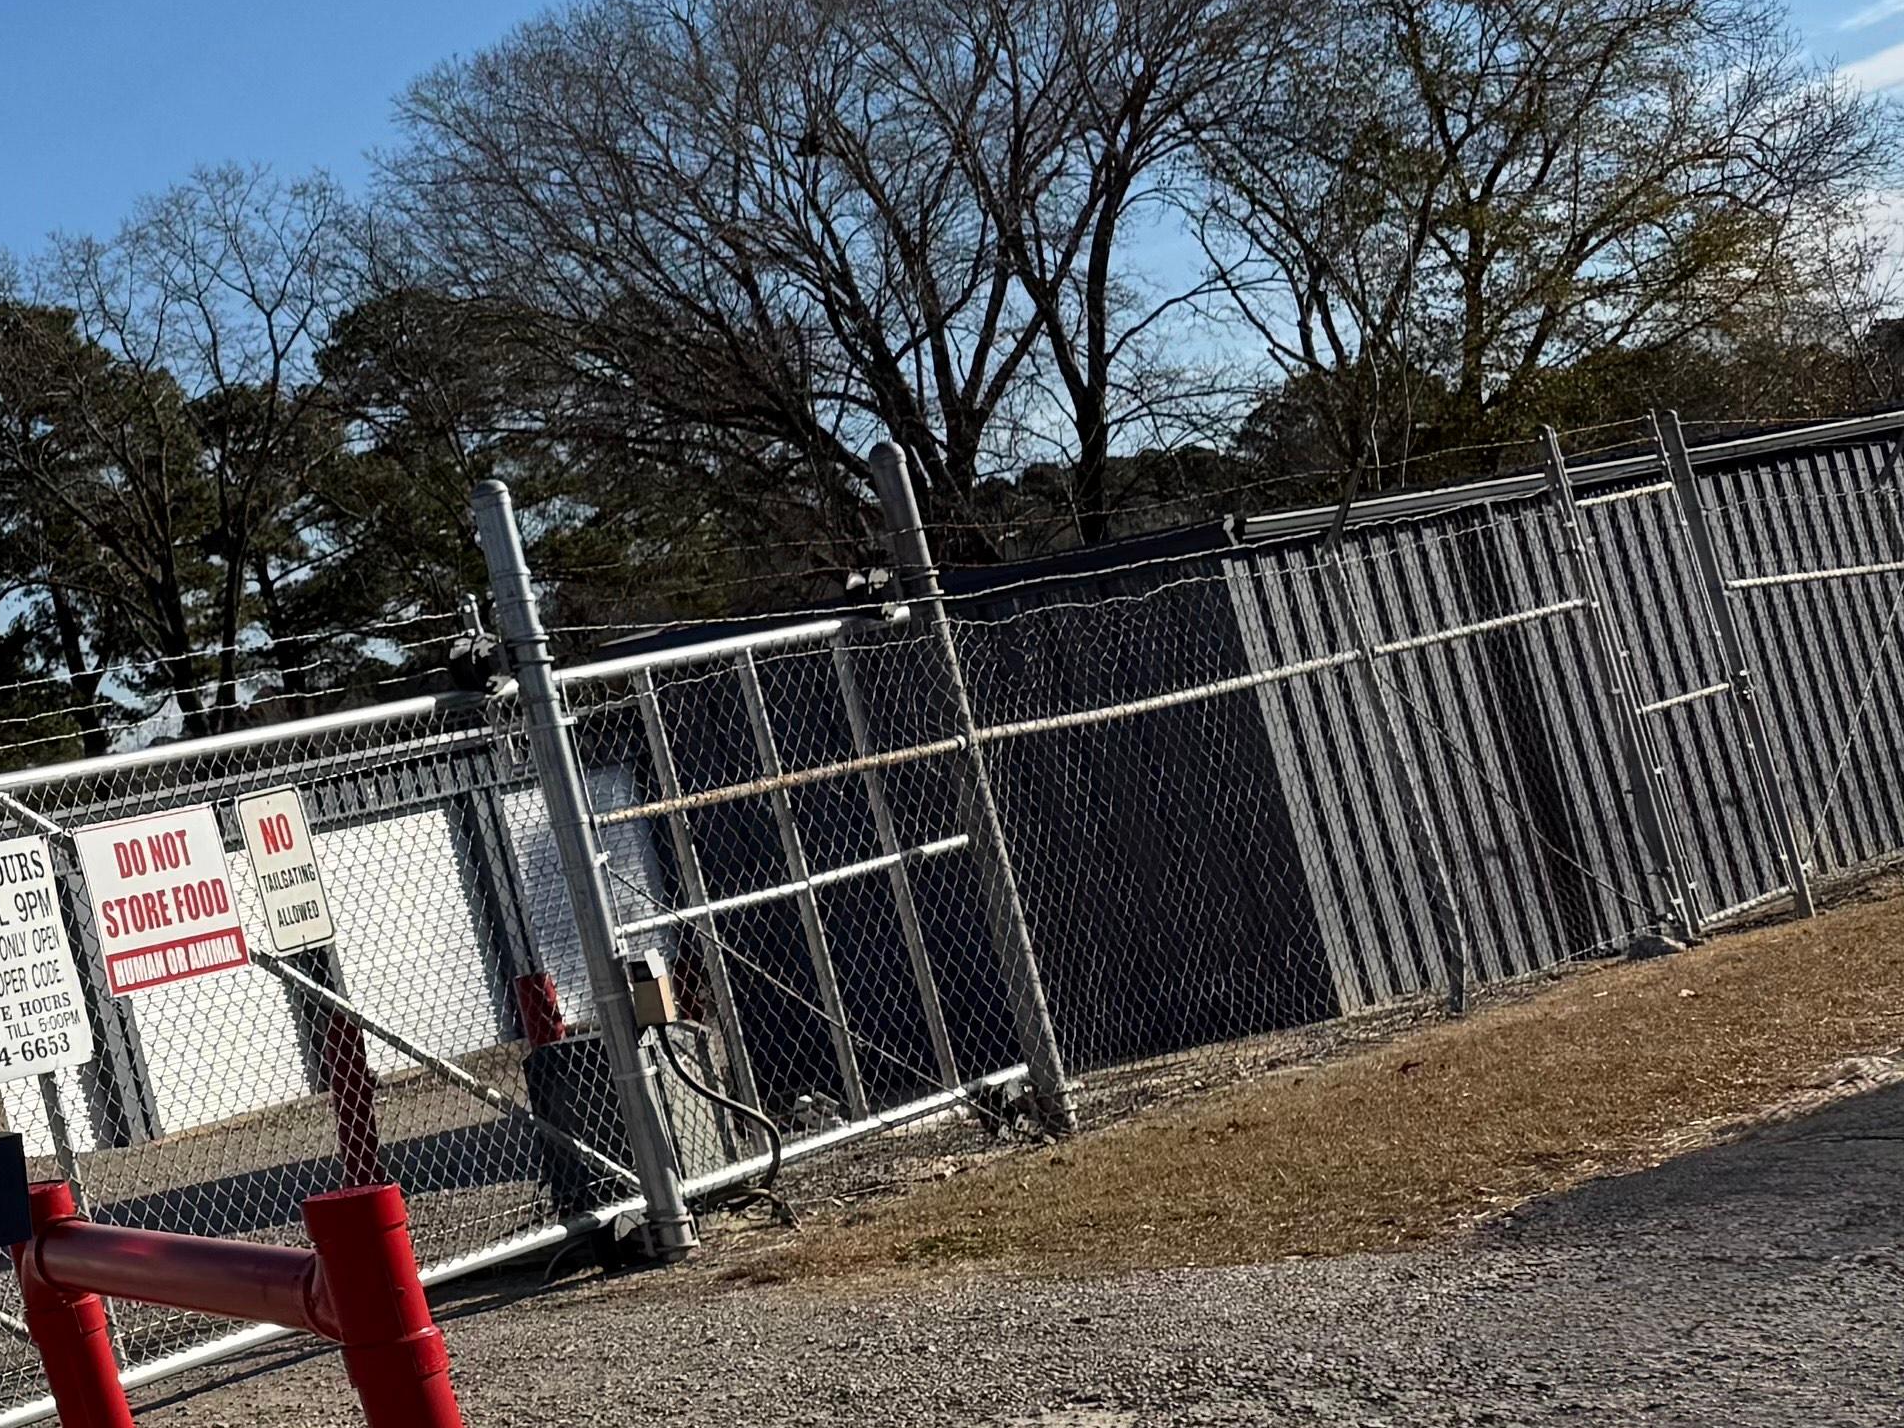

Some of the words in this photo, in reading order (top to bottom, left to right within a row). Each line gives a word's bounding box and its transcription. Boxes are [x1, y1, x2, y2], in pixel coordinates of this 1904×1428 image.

[258, 813, 294, 855] NO
[113, 839, 147, 879] DO
[147, 829, 191, 873] NOT
[261, 863, 316, 894] TAILGATING
[14, 887, 54, 922] 9PM
[101, 888, 173, 939] STORE
[171, 878, 230, 924] FOOD
[276, 899, 320, 928] ALLOWED
[32, 924, 61, 955] OPEN
[112, 950, 165, 988] HUMAN
[166, 946, 190, 976] OR
[187, 934, 242, 972] ANIMAL
[19, 991, 72, 1018] HOURS
[5, 1022, 34, 1042] TILL
[39, 1008, 81, 1033] 5:00PM
